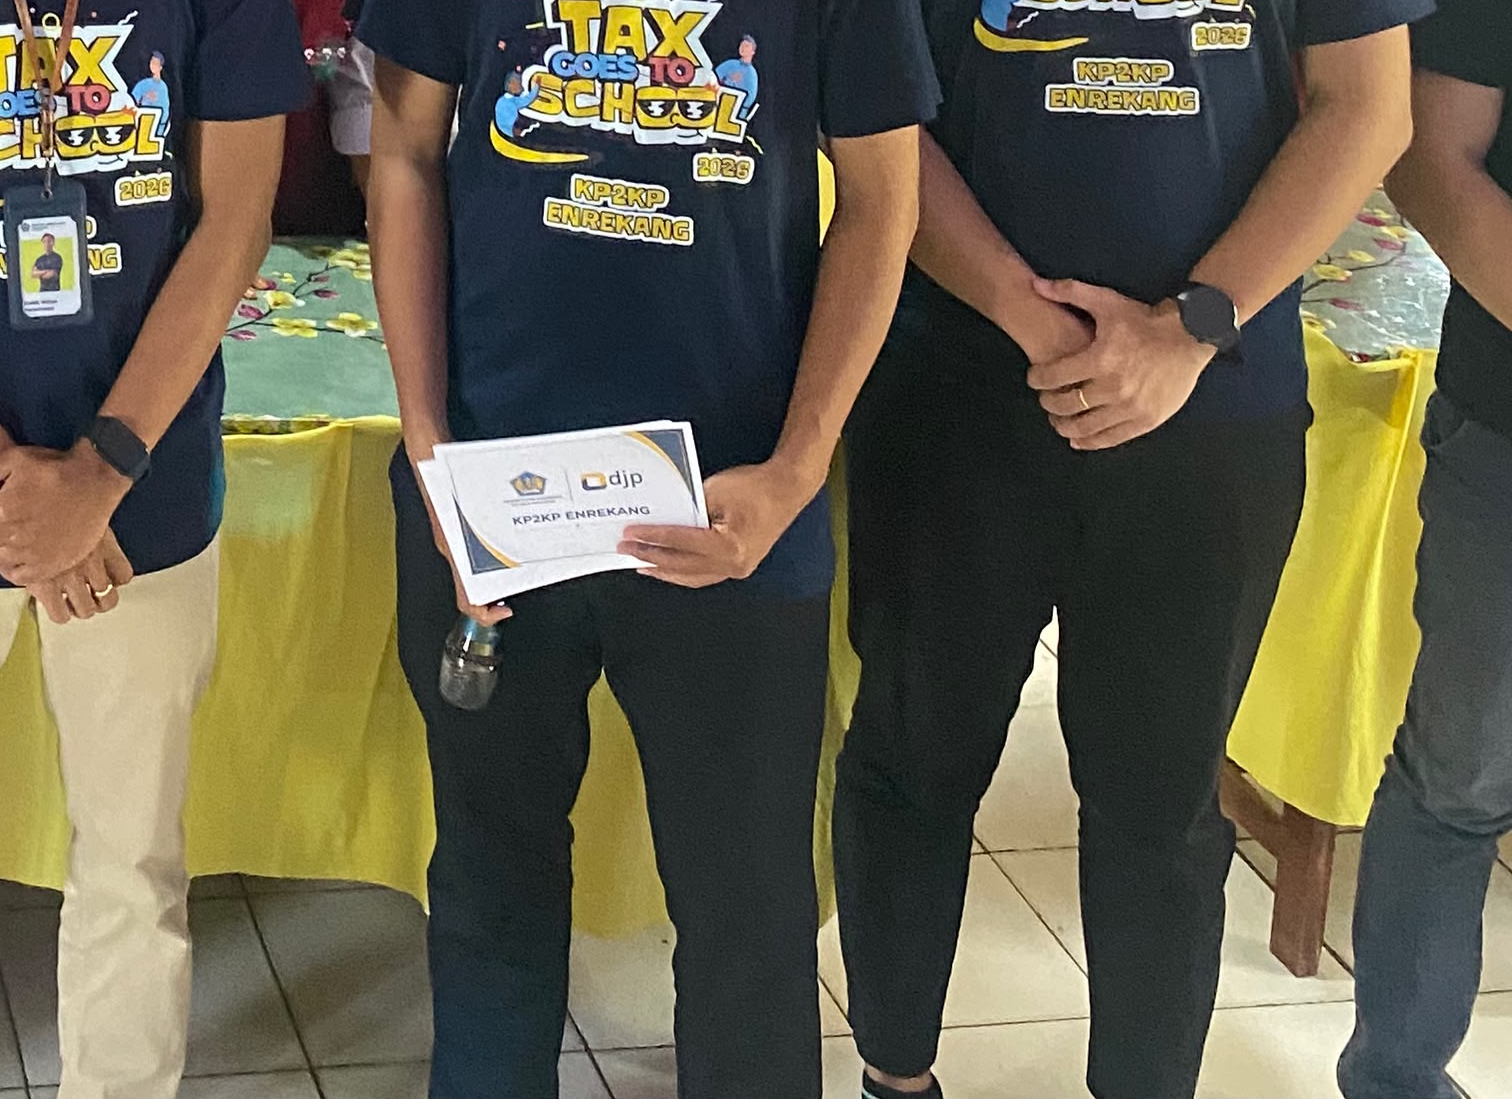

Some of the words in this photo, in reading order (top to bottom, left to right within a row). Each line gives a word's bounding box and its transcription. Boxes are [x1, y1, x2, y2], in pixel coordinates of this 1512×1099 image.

[549, 50, 639, 82] GOES
[648, 56, 696, 86] TO
[1076, 60, 1170, 83] KP2KP
[67, 84, 112, 114] TO
[529, 71, 745, 136] SCHOOL
[1049, 87, 1197, 112] ENREKANG
[573, 177, 666, 209] KP2KP
[546, 201, 691, 242] ENREKANG
[608, 470, 643, 489] djp
[512, 512, 561, 526] KP2KP
[565, 506, 650, 520] ENREKANG
